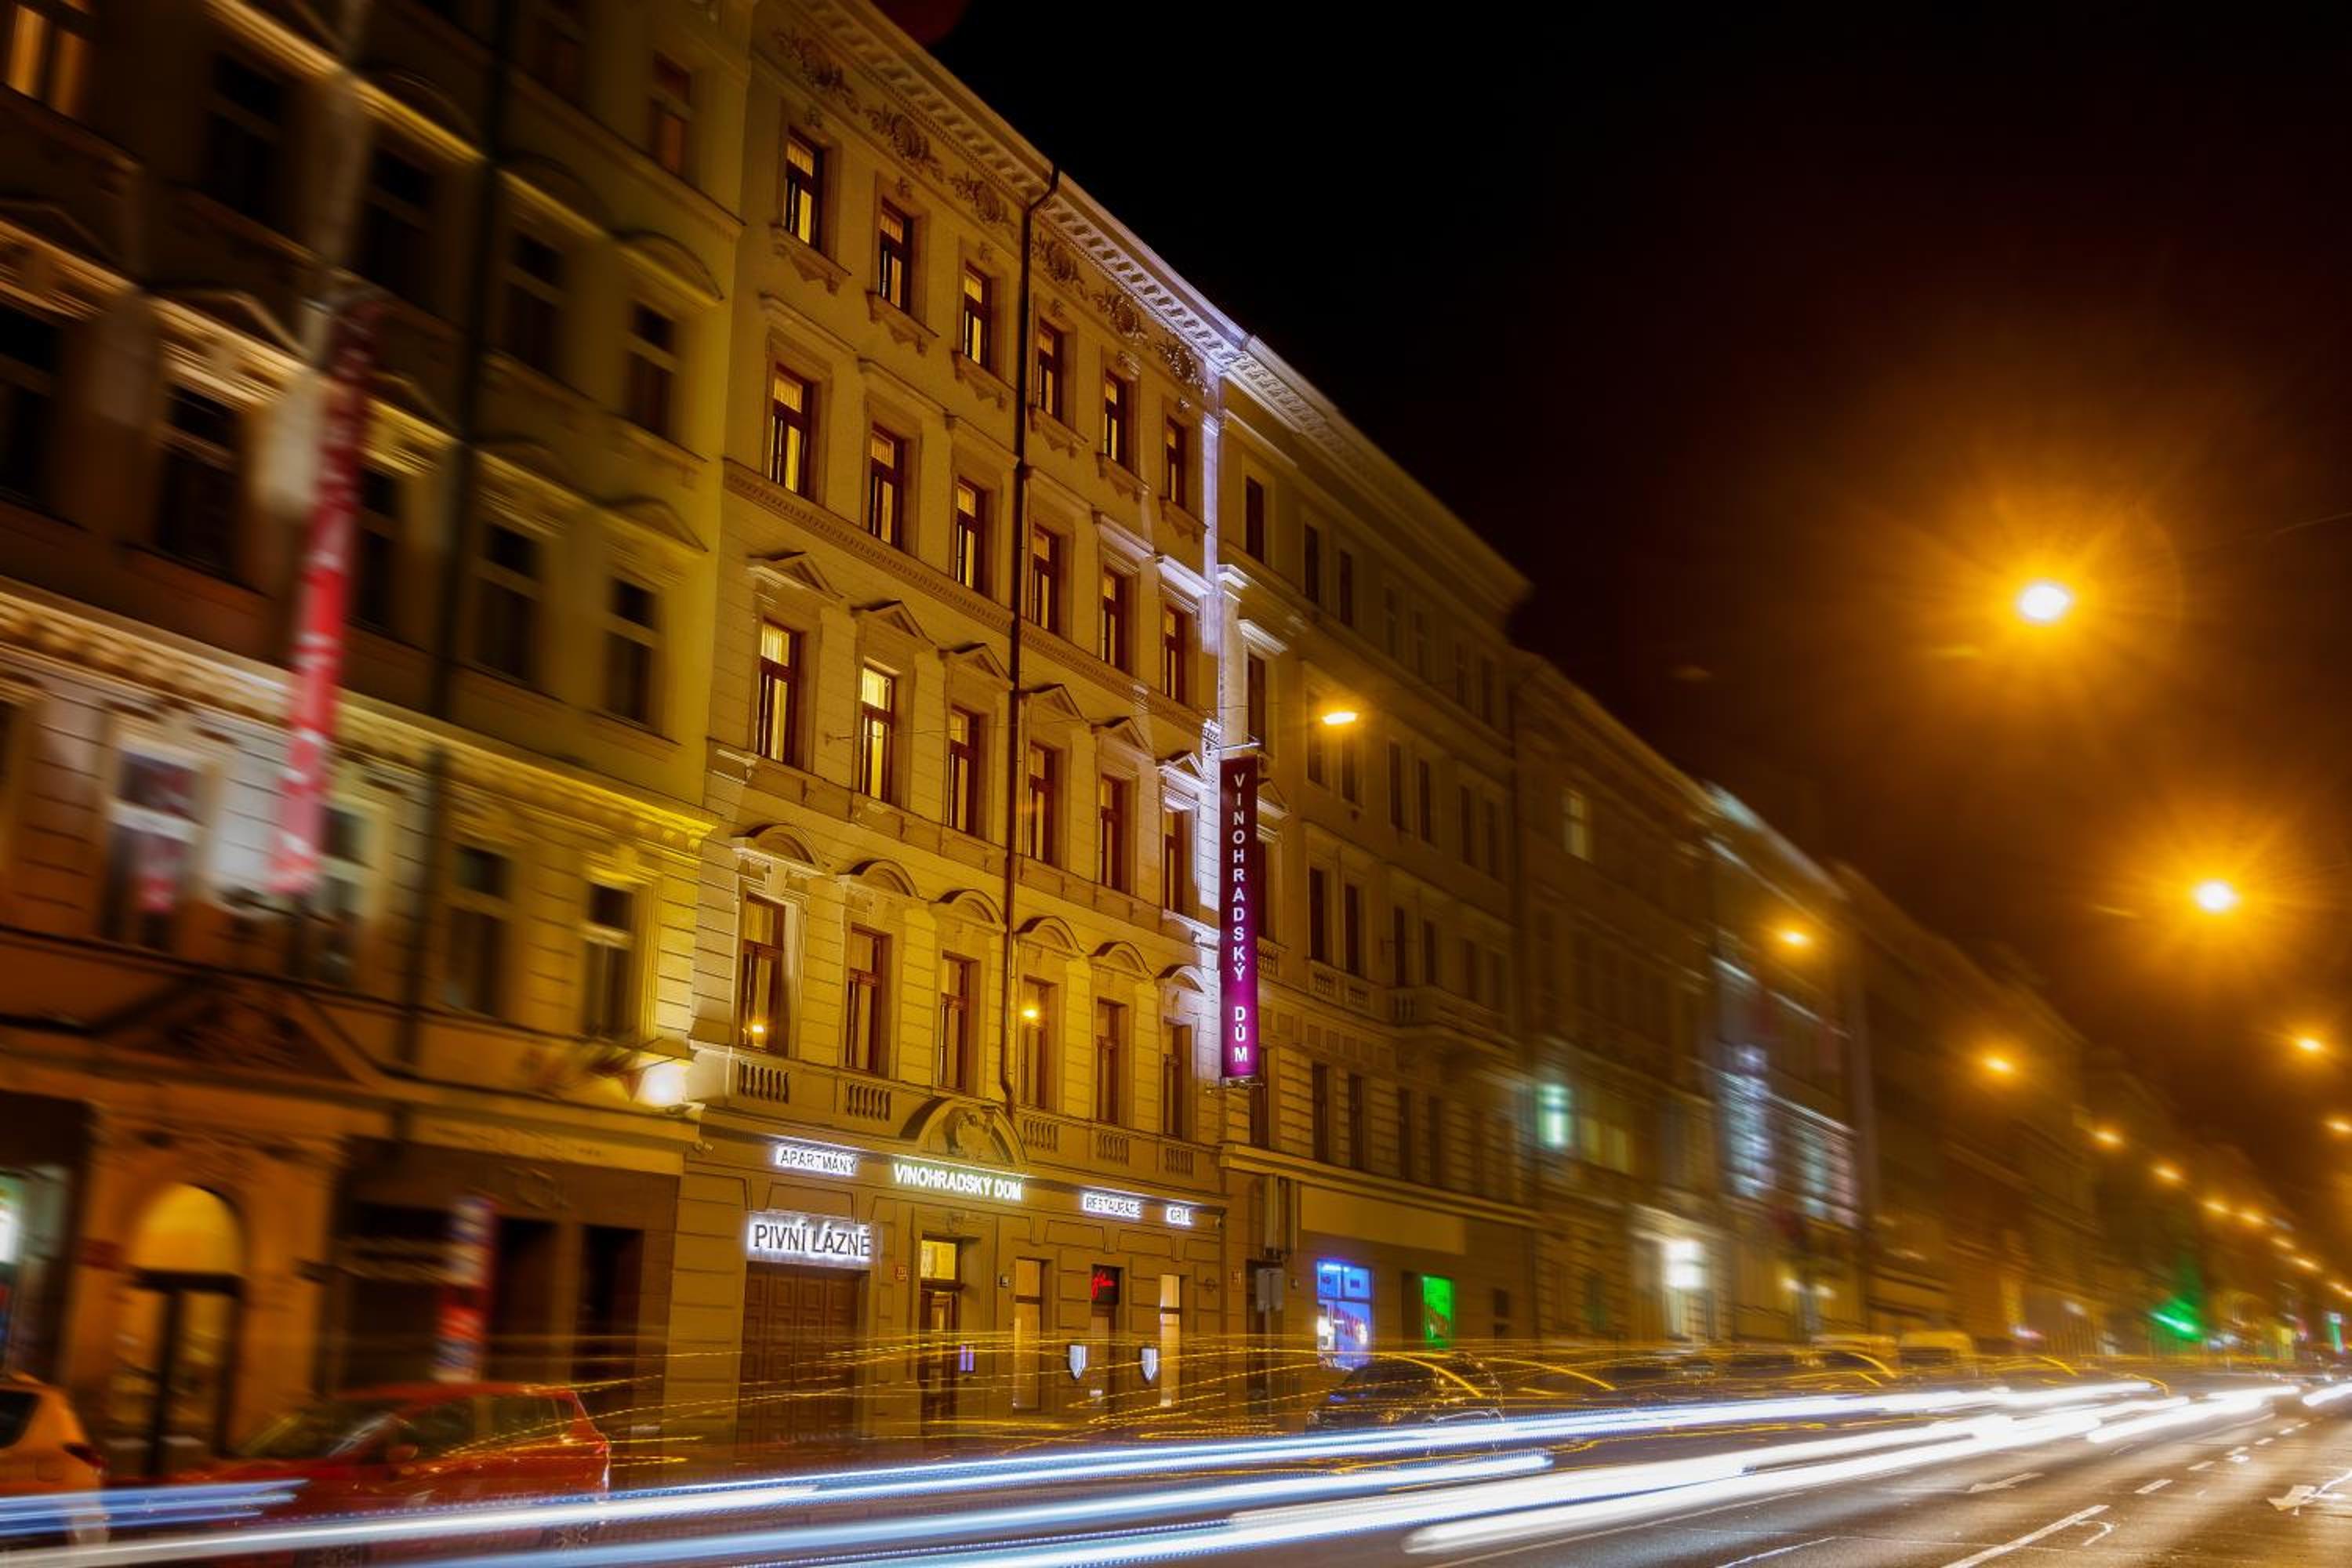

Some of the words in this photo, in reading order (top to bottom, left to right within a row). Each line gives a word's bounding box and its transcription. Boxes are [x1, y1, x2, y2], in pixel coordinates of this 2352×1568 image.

[1232, 772, 1247, 982] VINOHRADSKÝ
[779, 1148, 856, 1174] APARTMÁNY
[894, 1163, 993, 1196] VINOHRADSKÝ
[753, 1221, 808, 1252] PIVNÍ
[811, 1225, 872, 1258] LÁZNĚ
